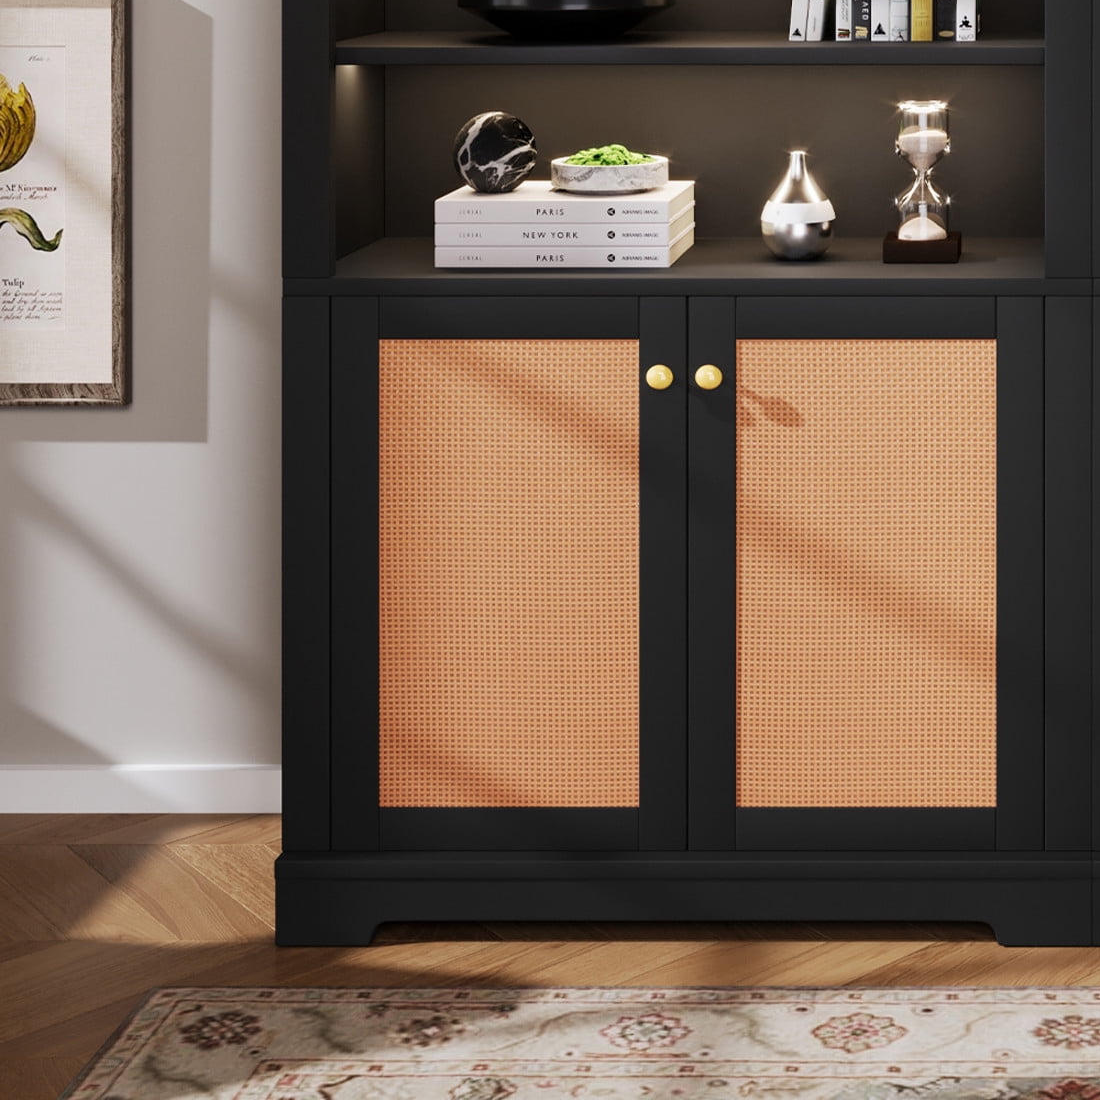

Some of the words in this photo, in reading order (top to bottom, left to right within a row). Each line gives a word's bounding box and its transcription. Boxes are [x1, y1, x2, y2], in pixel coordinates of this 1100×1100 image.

[536, 208, 565, 216] PARIS
[522, 231, 546, 239] NEW
[551, 231, 579, 239] YORK
[536, 254, 565, 262] PARIS
[2, 278, 25, 289] Tulip
